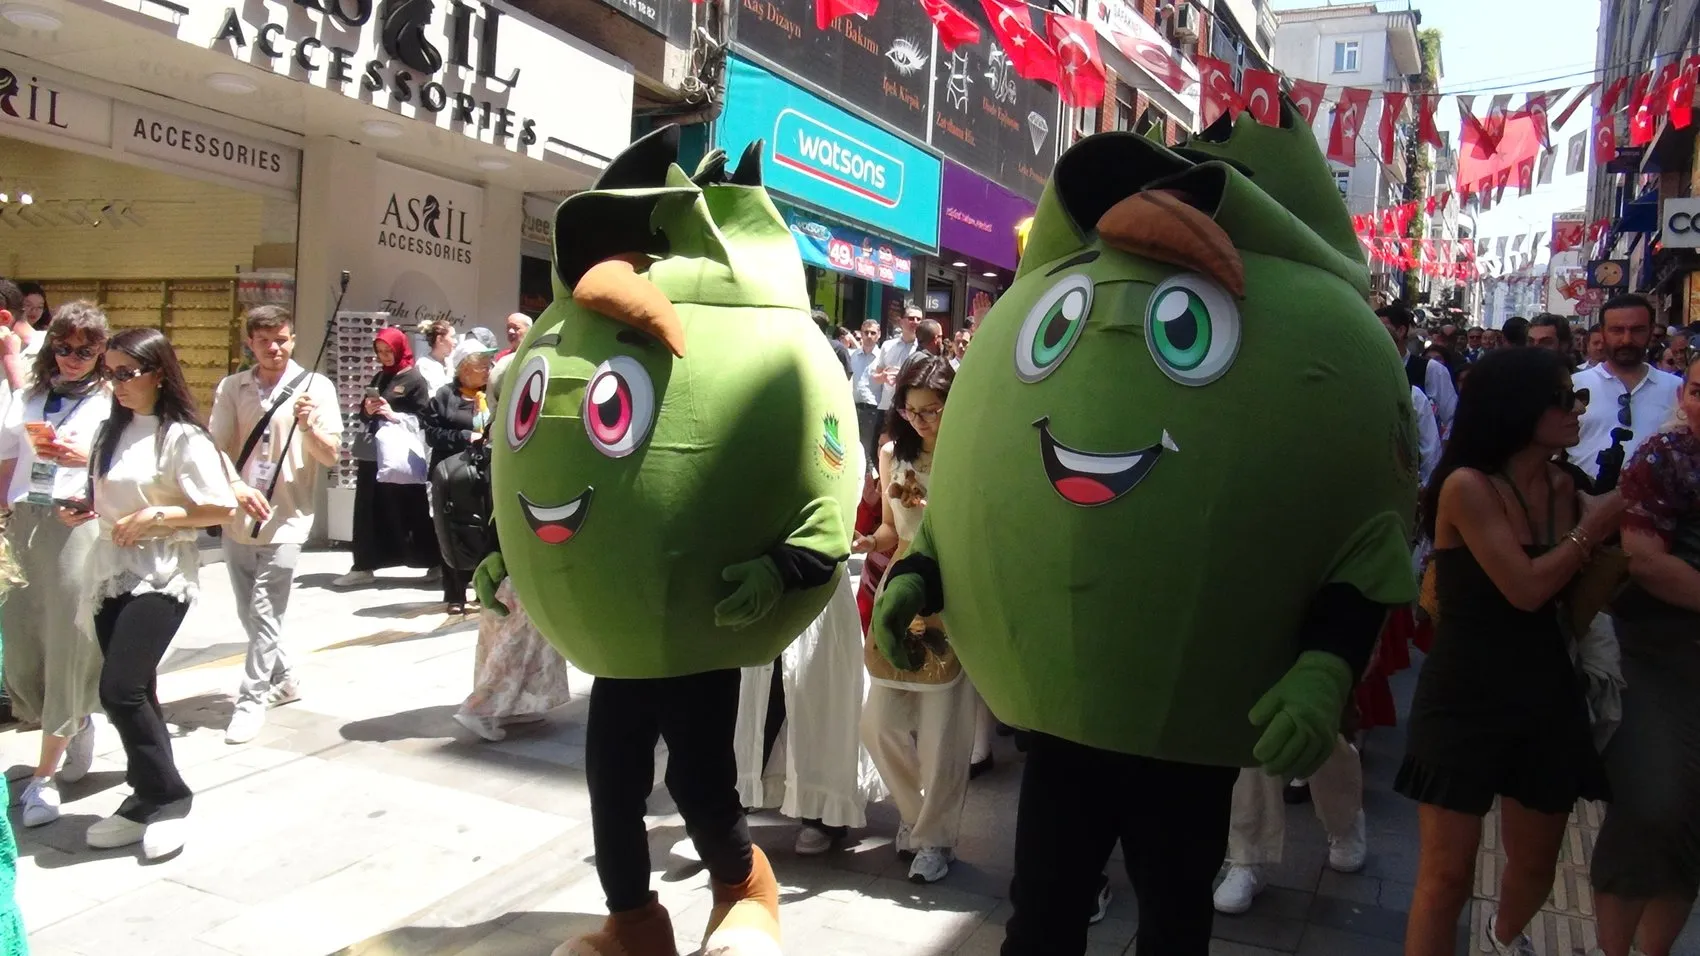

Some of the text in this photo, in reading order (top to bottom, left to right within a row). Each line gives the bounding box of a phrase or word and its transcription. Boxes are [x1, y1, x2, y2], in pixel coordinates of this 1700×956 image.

[766, 2, 802, 40] Dizayn
[214, 6, 537, 146] ACCESSORIES
[133, 117, 281, 173] ACCESSORIES
[798, 127, 886, 189] watsons
[379, 192, 472, 246] ASİL
[378, 230, 472, 265] ACCESSORIES
